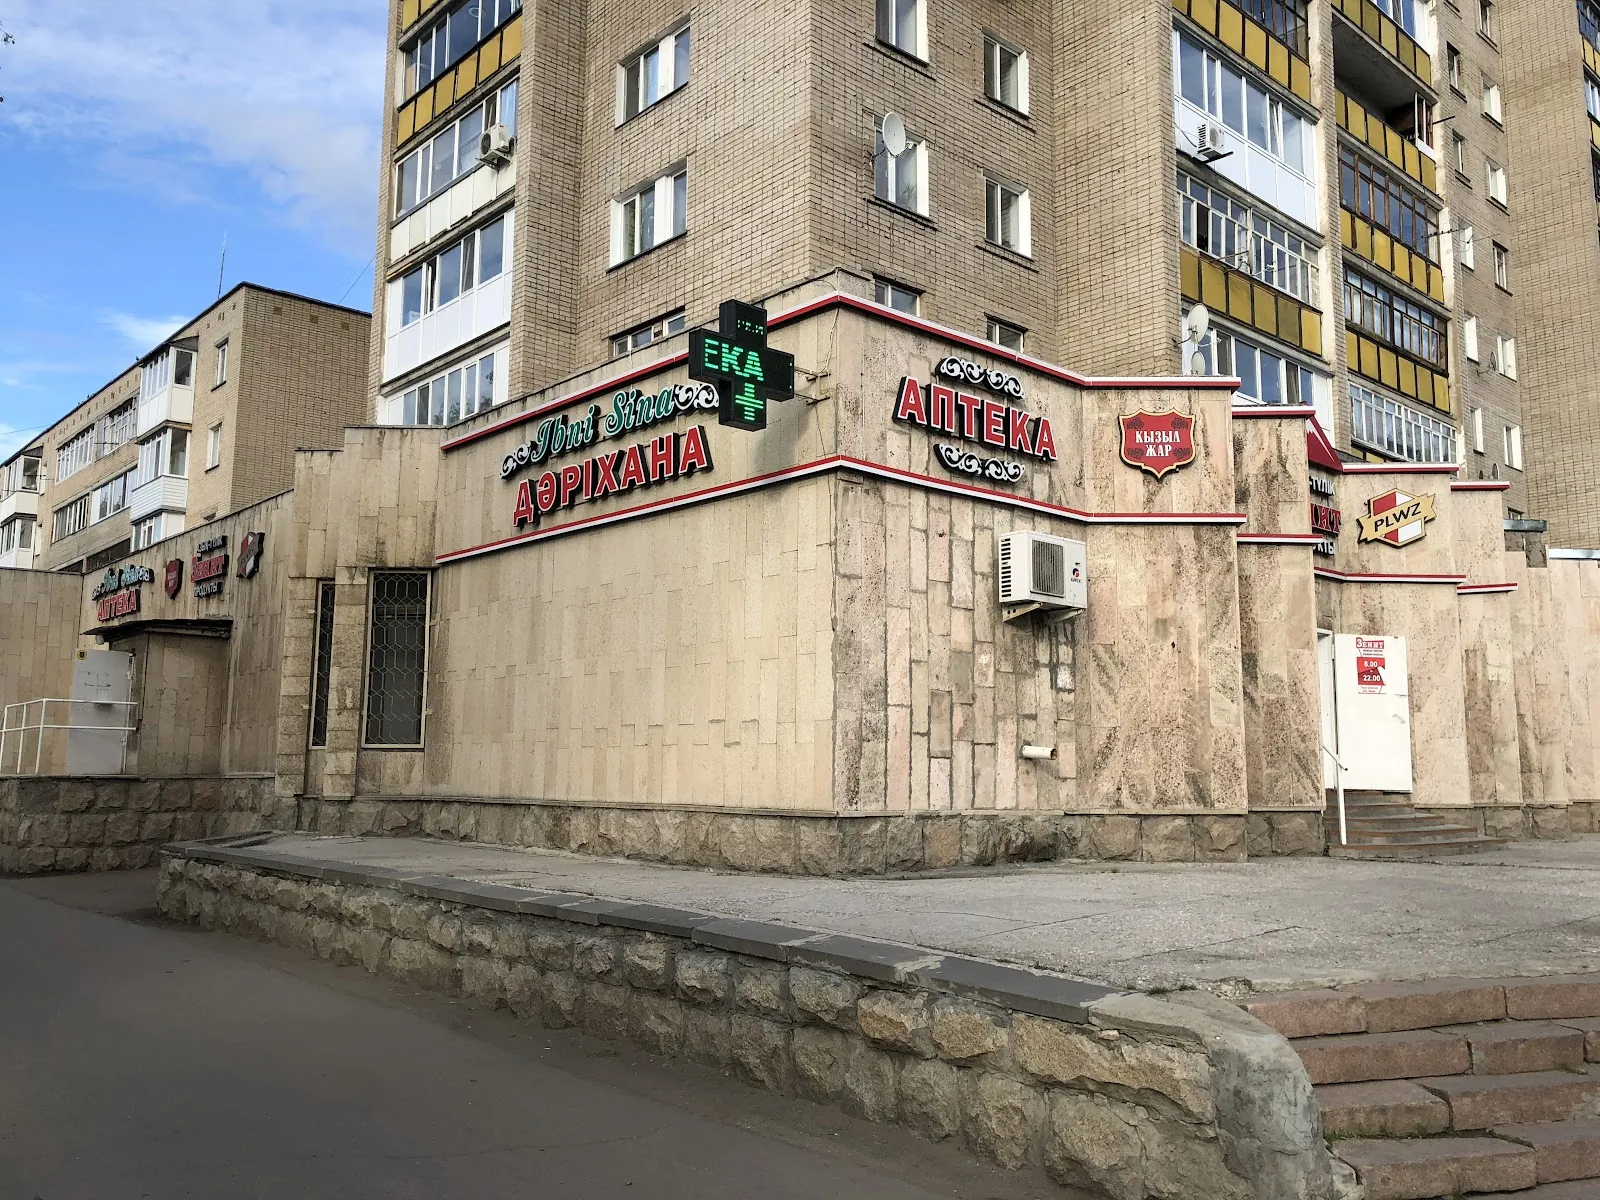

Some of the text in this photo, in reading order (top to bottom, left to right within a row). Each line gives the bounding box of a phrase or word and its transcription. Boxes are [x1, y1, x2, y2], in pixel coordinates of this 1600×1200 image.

[530, 384, 675, 462] Ibni Sina
[897, 376, 1058, 461] АПТЕКА
[1135, 430, 1181, 444] КЫЗЫЛ
[1145, 444, 1172, 457] ЖАР
[512, 424, 708, 528] ДӘРІХАНА
[1374, 502, 1422, 533] PLWZ
[97, 589, 137, 621] АПТЕКА
[1363, 674, 1381, 682] 22.00
